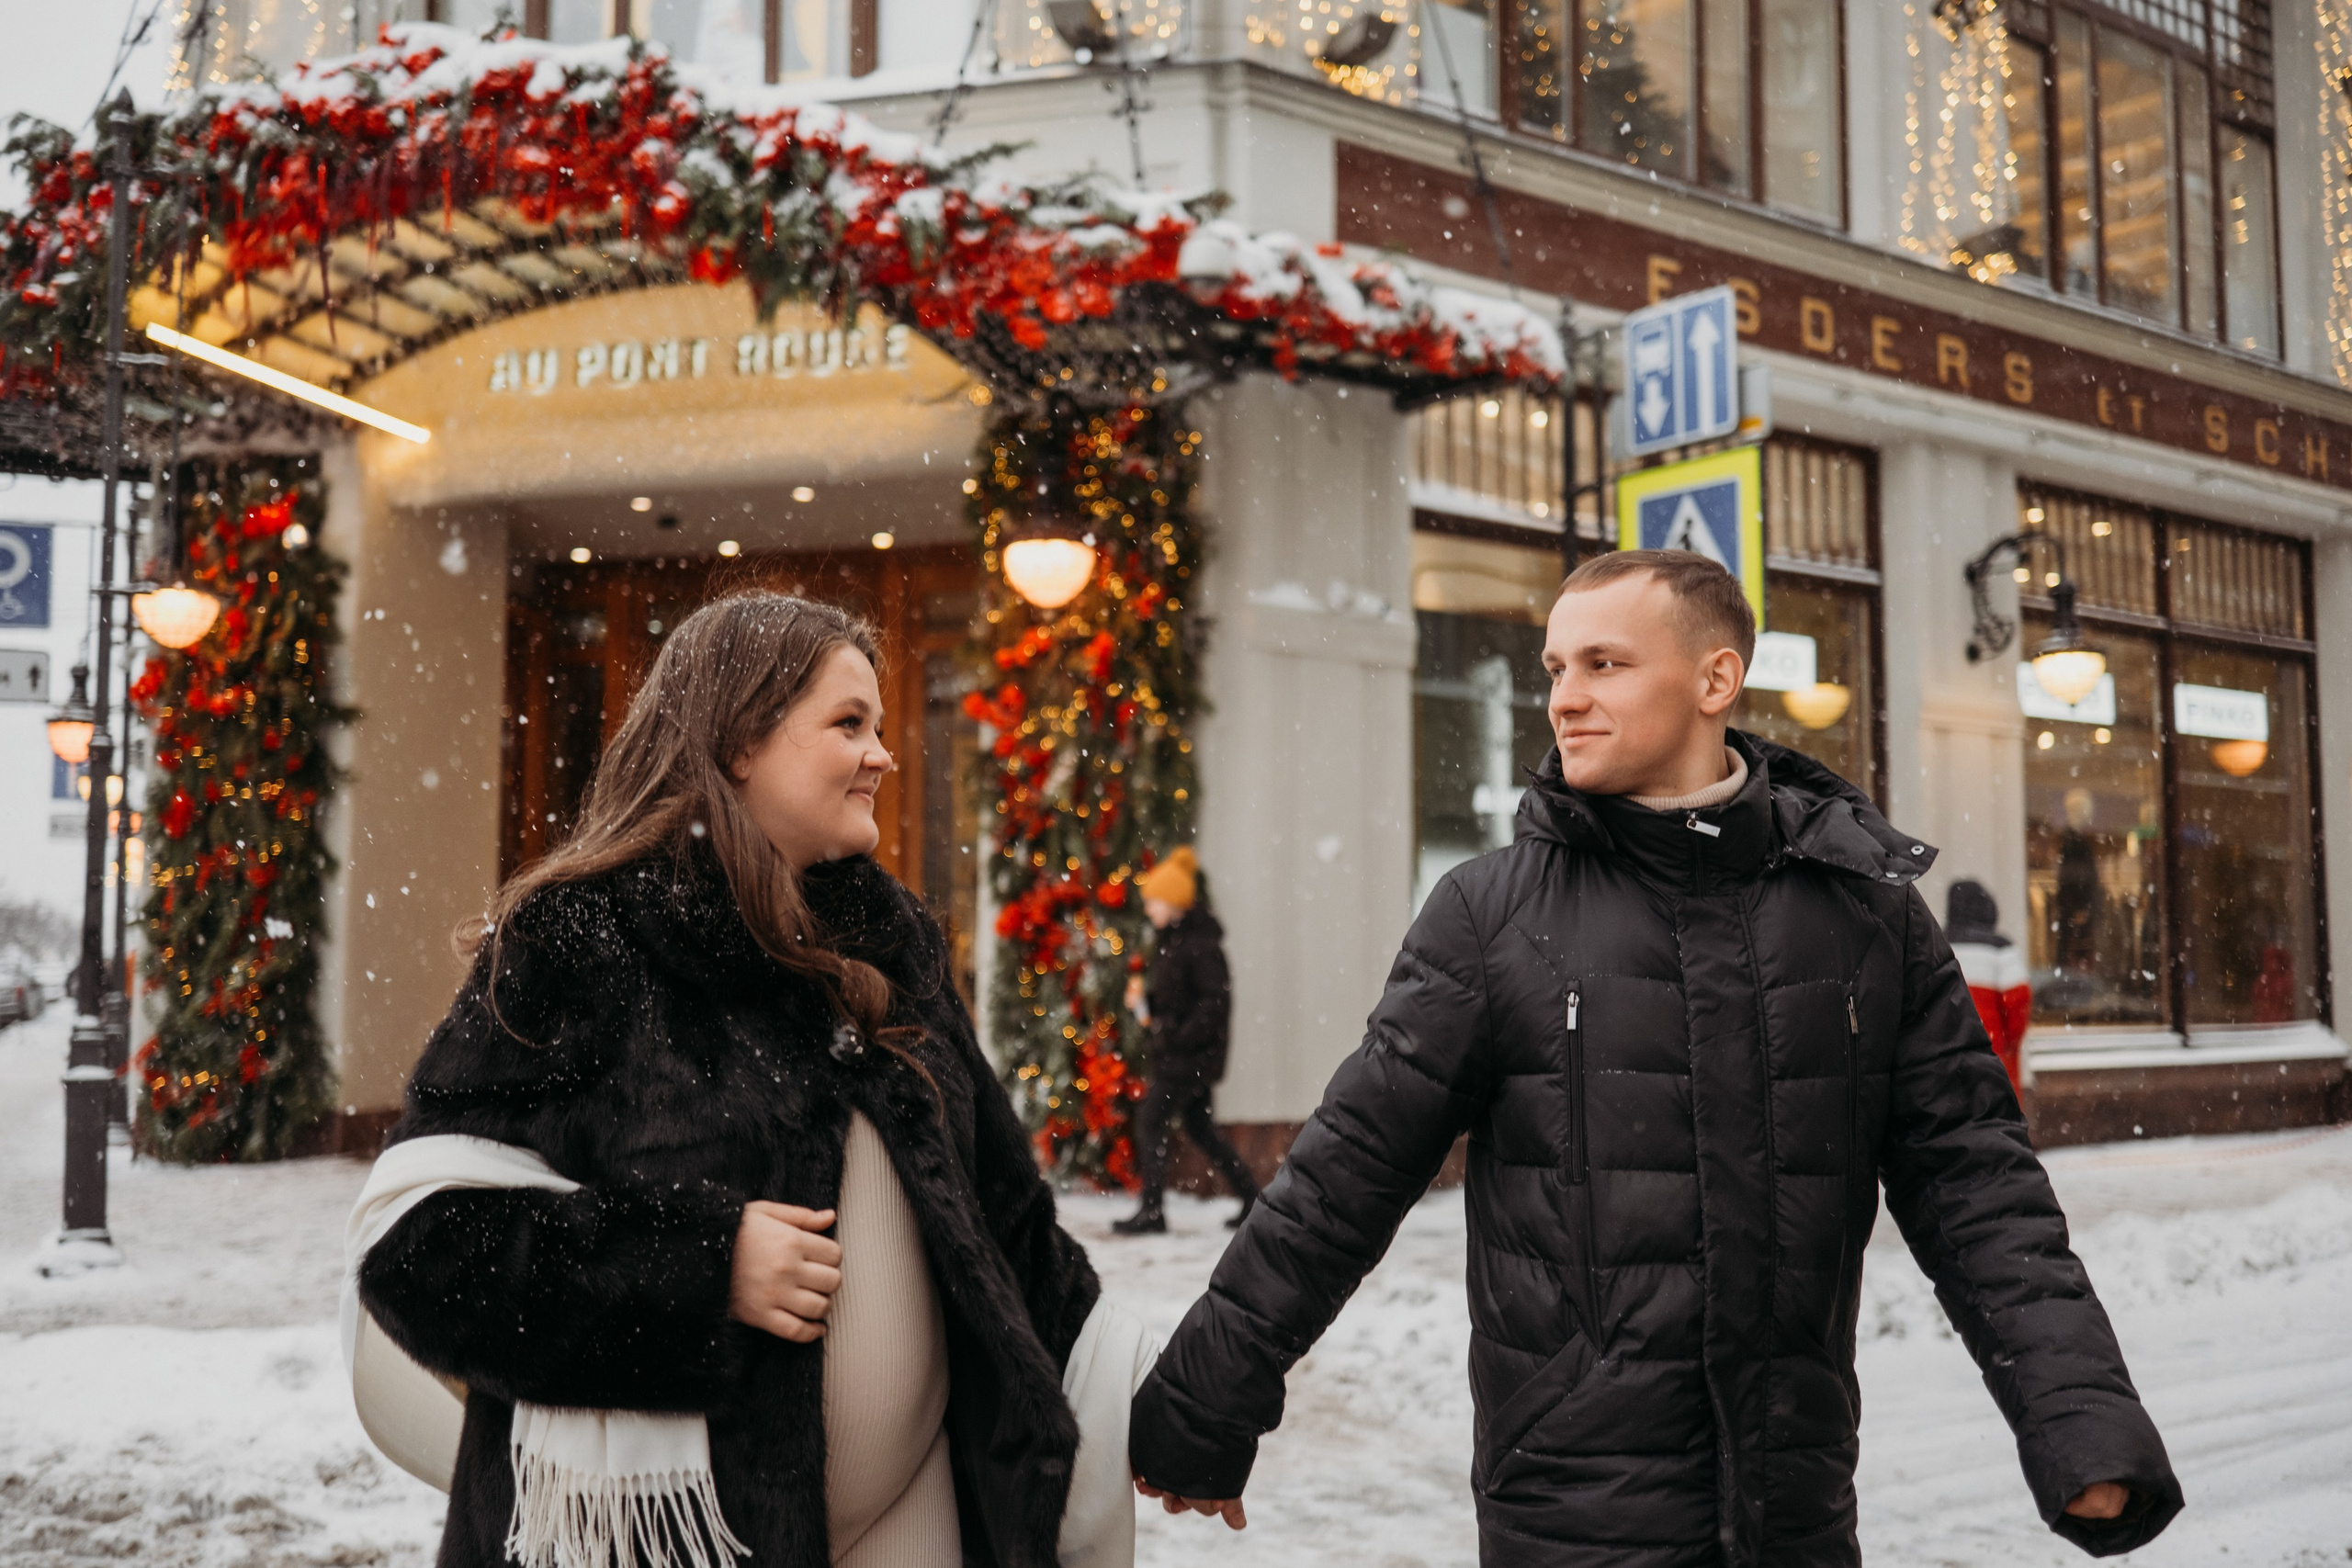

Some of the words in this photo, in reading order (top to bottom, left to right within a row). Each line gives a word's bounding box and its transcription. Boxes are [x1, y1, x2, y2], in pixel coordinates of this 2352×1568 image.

[491, 349, 559, 395] AU
[577, 342, 707, 389] PONT
[1647, 255, 2034, 404] ESDERS
[2204, 405, 2352, 479] SCH
